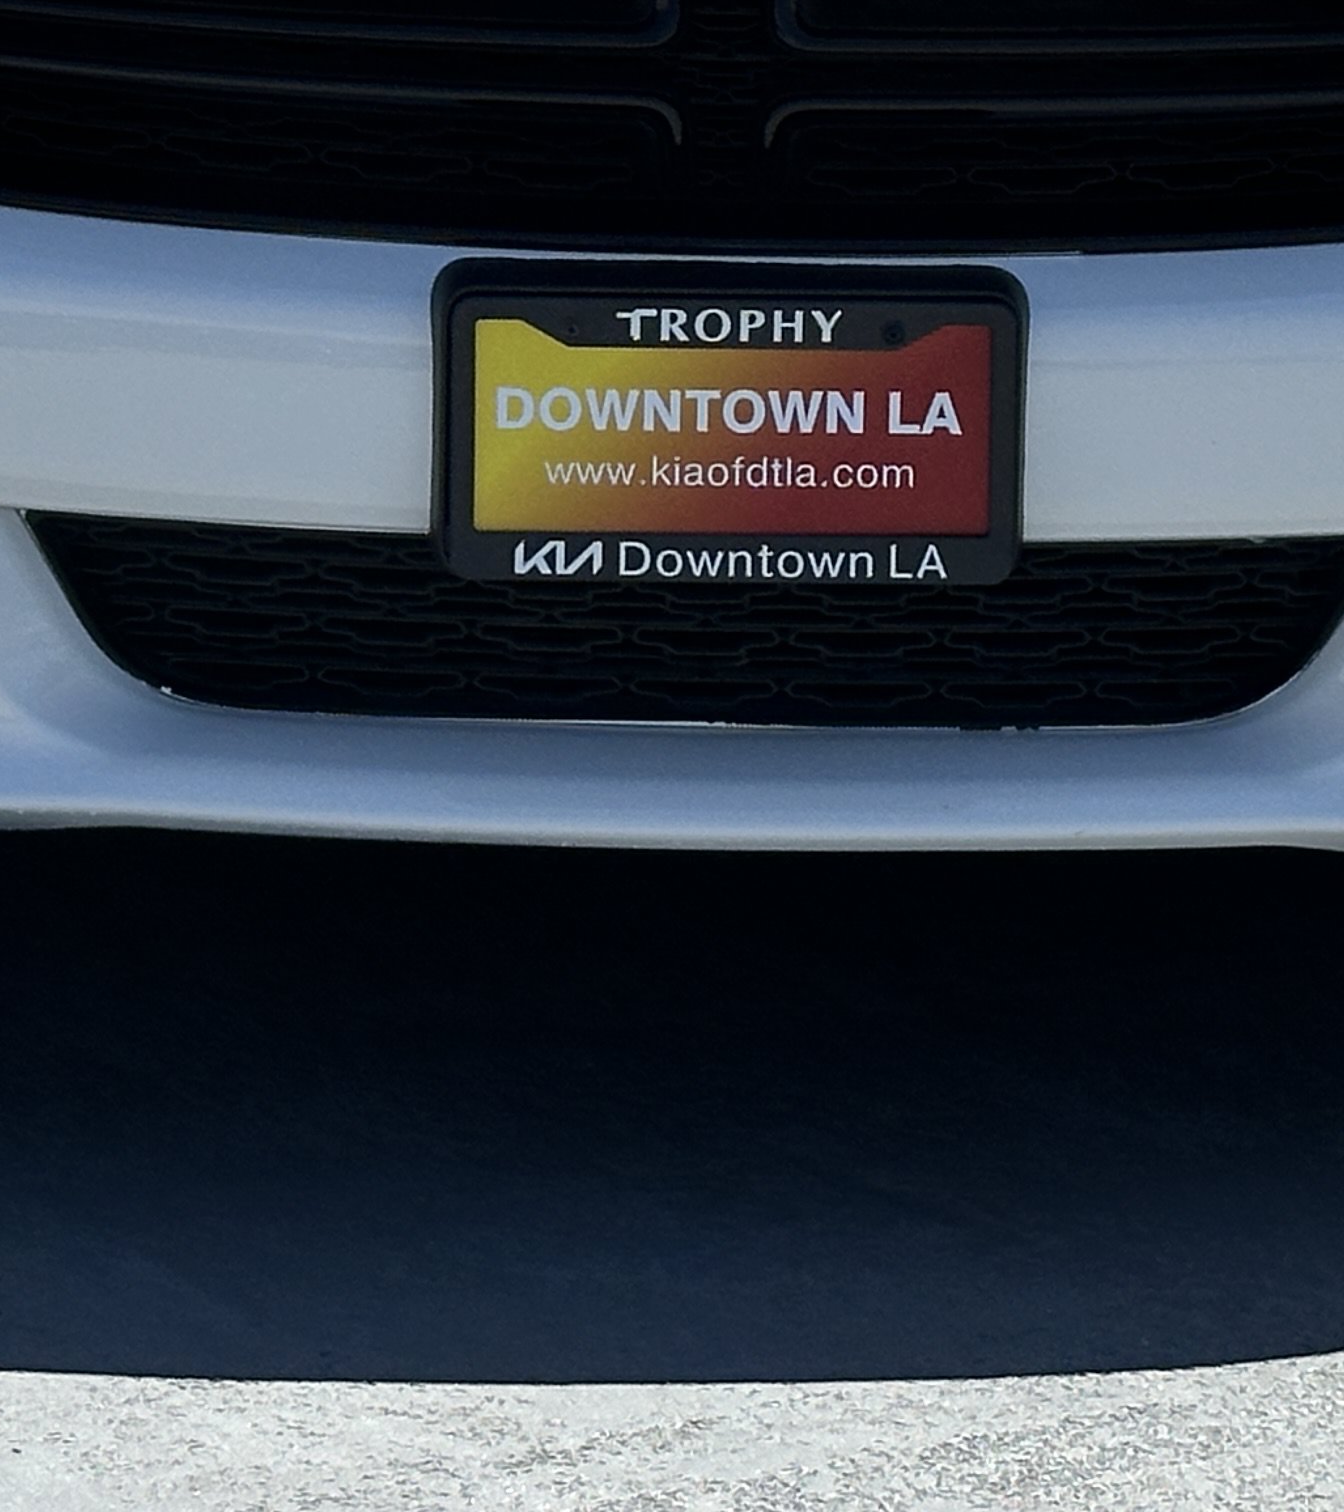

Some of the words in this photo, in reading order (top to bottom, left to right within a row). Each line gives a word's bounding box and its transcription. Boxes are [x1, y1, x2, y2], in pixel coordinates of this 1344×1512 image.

[616, 308, 842, 343] TROPHY
[495, 387, 865, 435] DOWNTOWN
[887, 392, 962, 436] LA
[544, 455, 915, 489] www.kiaofdtla.com
[618, 541, 874, 579] Downtown
[889, 544, 948, 580] LA
